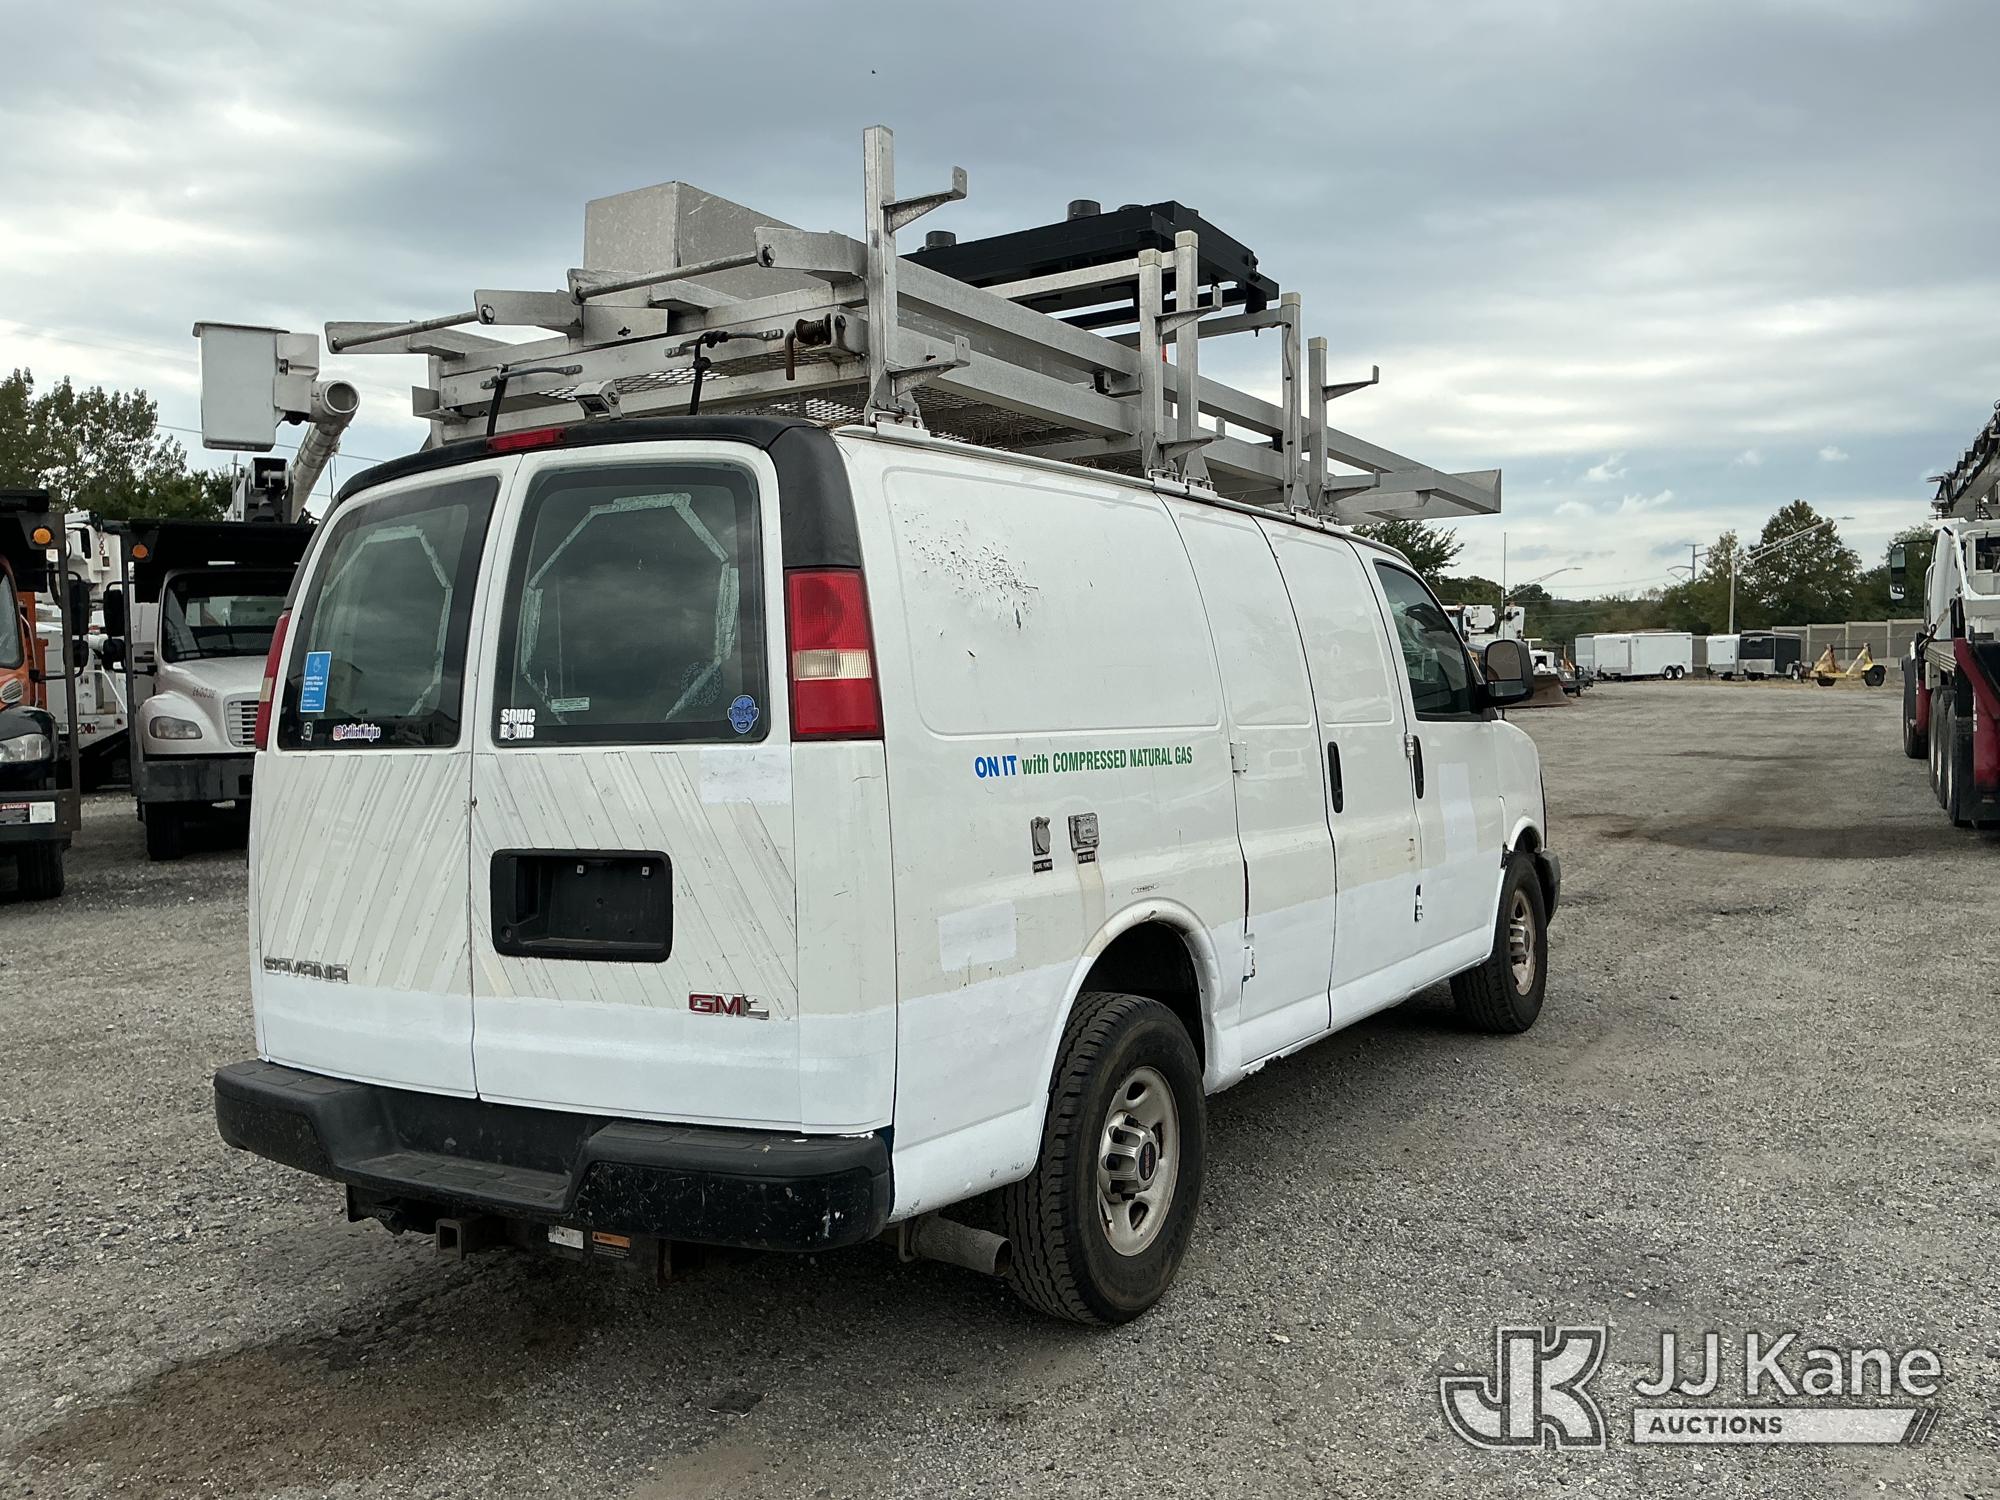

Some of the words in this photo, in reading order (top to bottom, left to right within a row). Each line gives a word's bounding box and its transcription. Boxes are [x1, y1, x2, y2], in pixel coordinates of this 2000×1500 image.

[501, 708, 536, 723] SONIC
[974, 756, 999, 778] ON
[1003, 755, 1017, 775] IT
[1022, 754, 1049, 774] with
[1052, 749, 1127, 773] COMPRESSED
[1129, 747, 1172, 767] NATURAL
[1175, 746, 1193, 764] GAS
[263, 955, 349, 984] SAVANA
